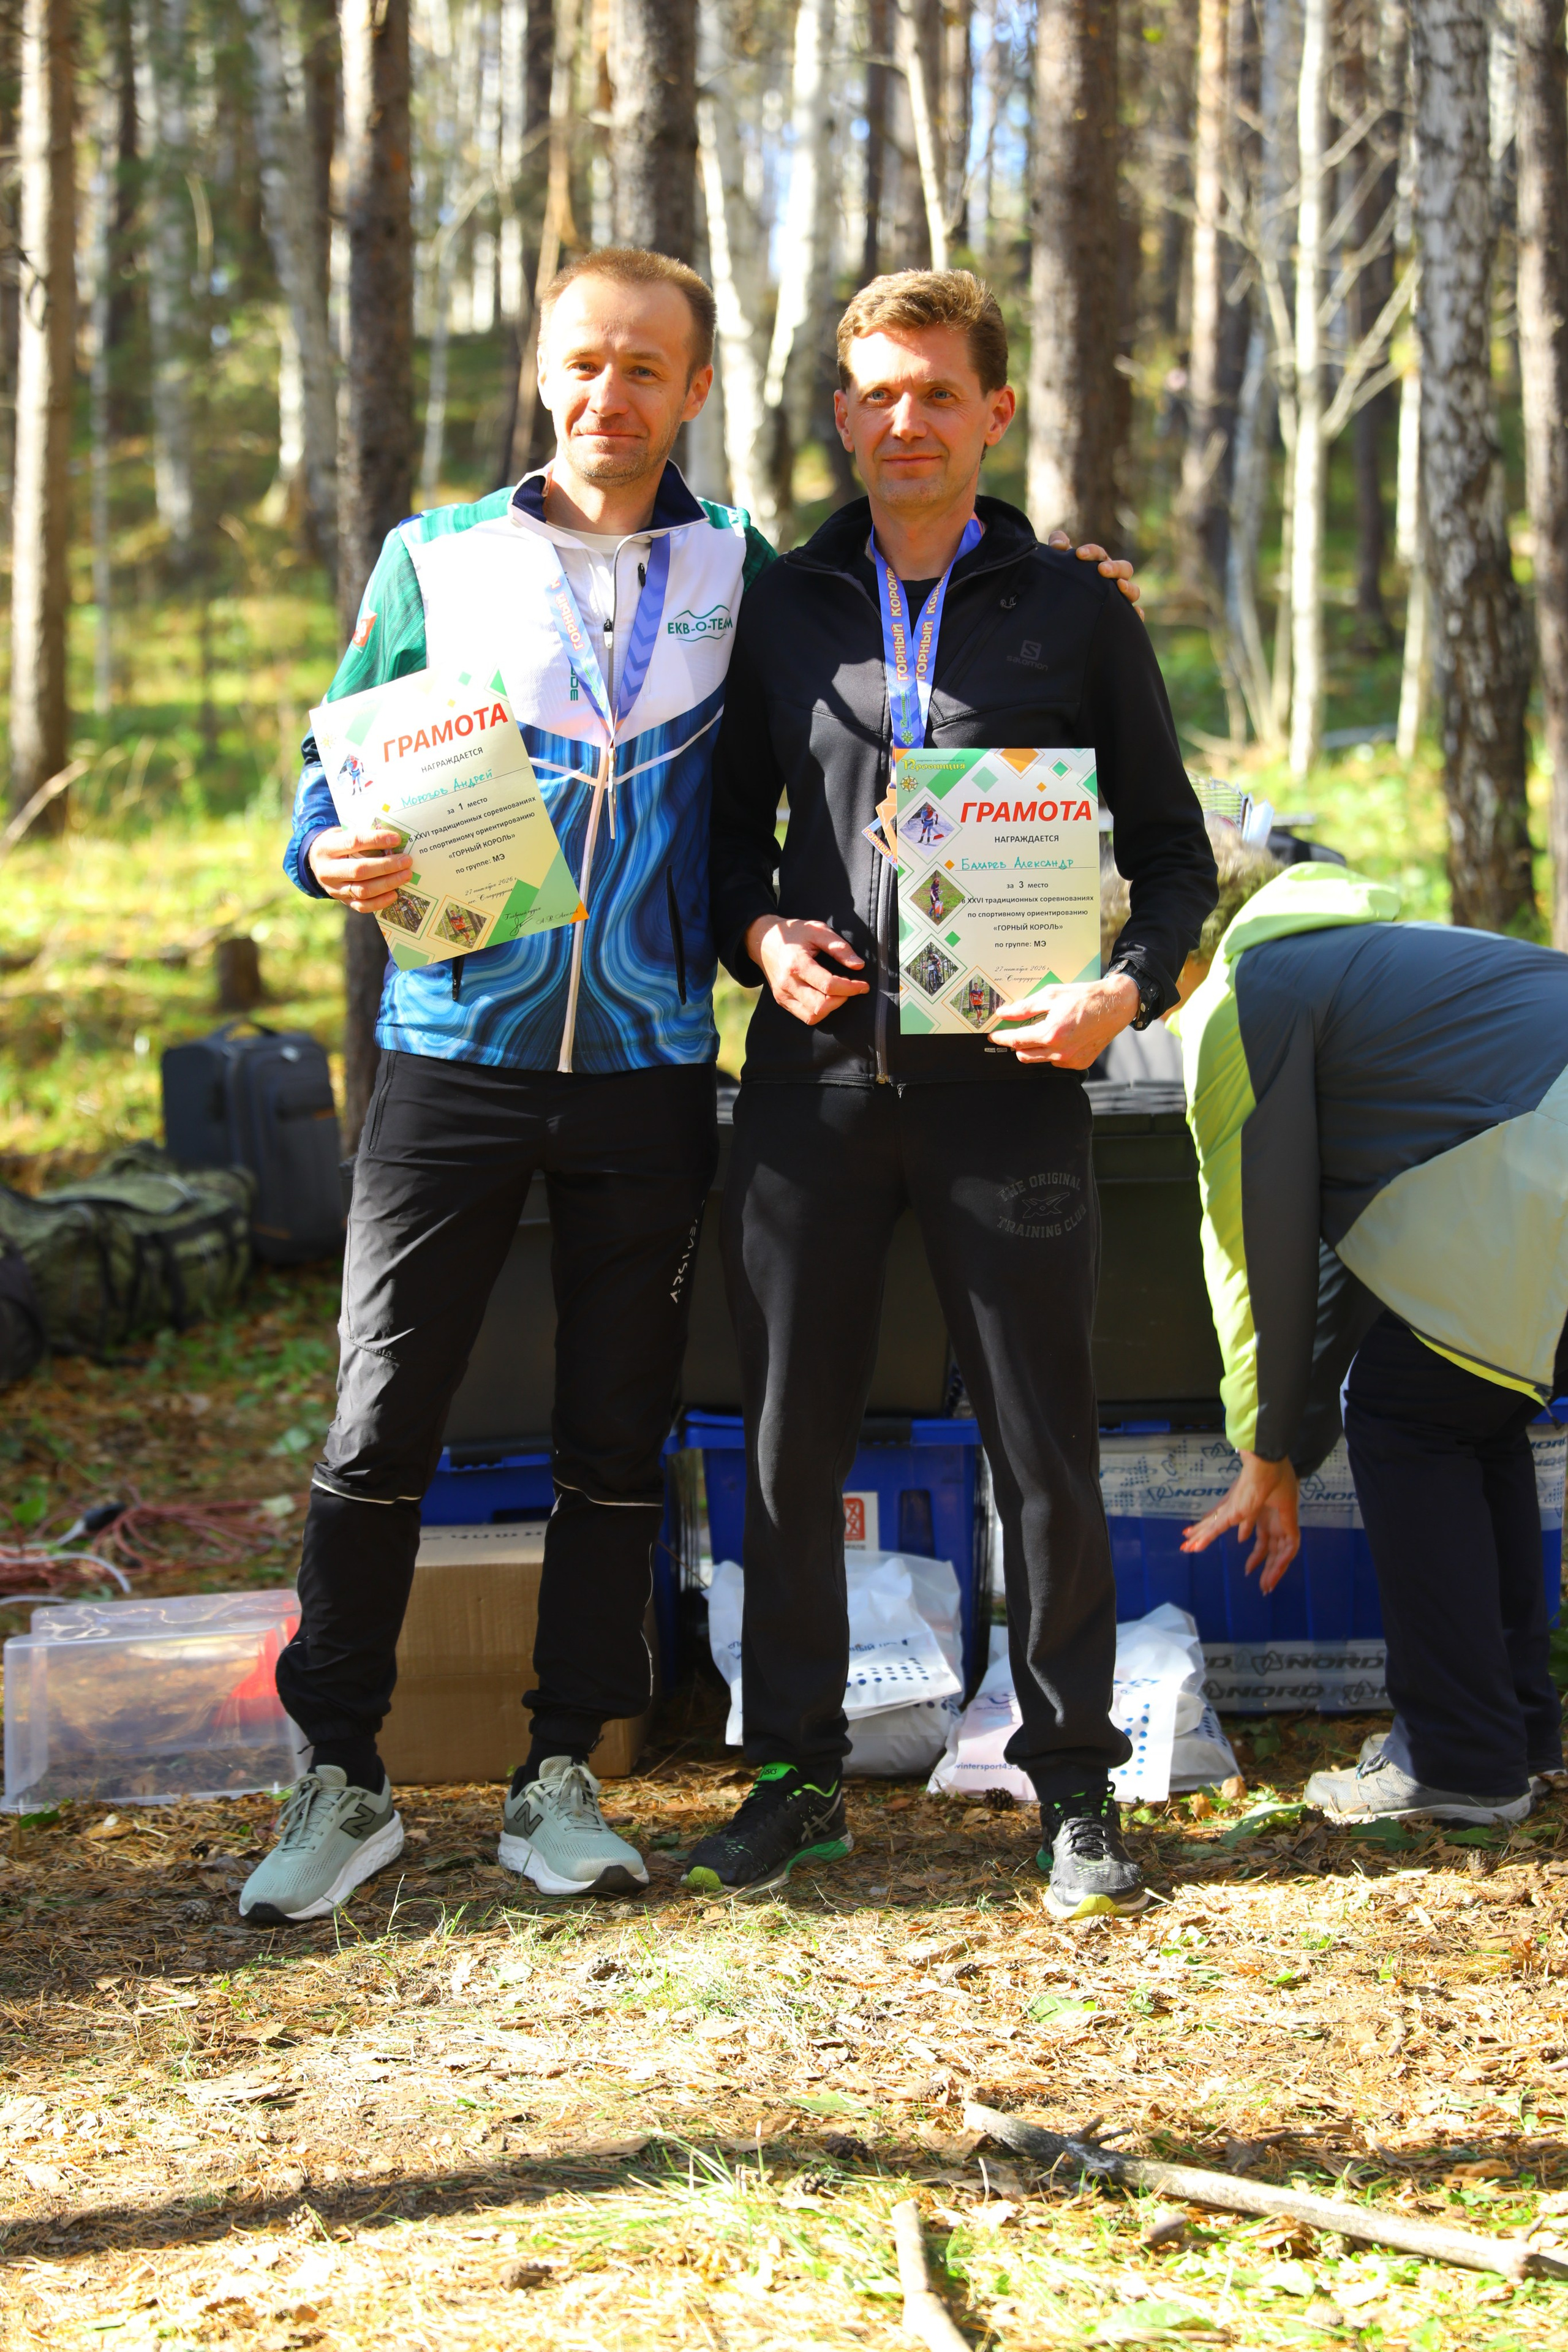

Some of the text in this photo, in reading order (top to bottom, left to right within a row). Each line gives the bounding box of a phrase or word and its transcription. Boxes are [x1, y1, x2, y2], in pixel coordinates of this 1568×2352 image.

[886, 567, 902, 617] КОРОЛЬ
[668, 616, 733, 635] EKB-O-TEAM
[891, 623, 909, 682] ГОРНЫЙ
[916, 620, 933, 680] ГОРНЫЙ
[383, 703, 508, 763] ГРАМОТА
[421, 747, 483, 773] НАГРАЖДАЕТСЯ
[458, 802, 464, 811] 1
[467, 797, 488, 809] место
[960, 801, 1092, 823] ГРАМОТА
[414, 831, 430, 841] XXVI
[431, 814, 483, 835] традиционных
[483, 796, 537, 818] соревнованиях
[429, 832, 475, 852] спортивному
[475, 812, 535, 836] ориентированию
[995, 835, 1059, 843] НАГРАЖДАЕТСЯ
[448, 833, 516, 859] «ГОРНЫЙ КОРОЛЬ»
[466, 858, 491, 872] группе:
[492, 853, 505, 863] МЭ
[993, 922, 1028, 931] «ГОРНЫЙ
[996, 1172, 1082, 1202] THE ORIGINAL
[997, 1204, 1087, 1238] TRAINING CLUB
[1314, 1491, 1359, 1501] NOR
[1287, 1656, 1384, 1669] NORD
[1226, 1685, 1324, 1698] NORD
